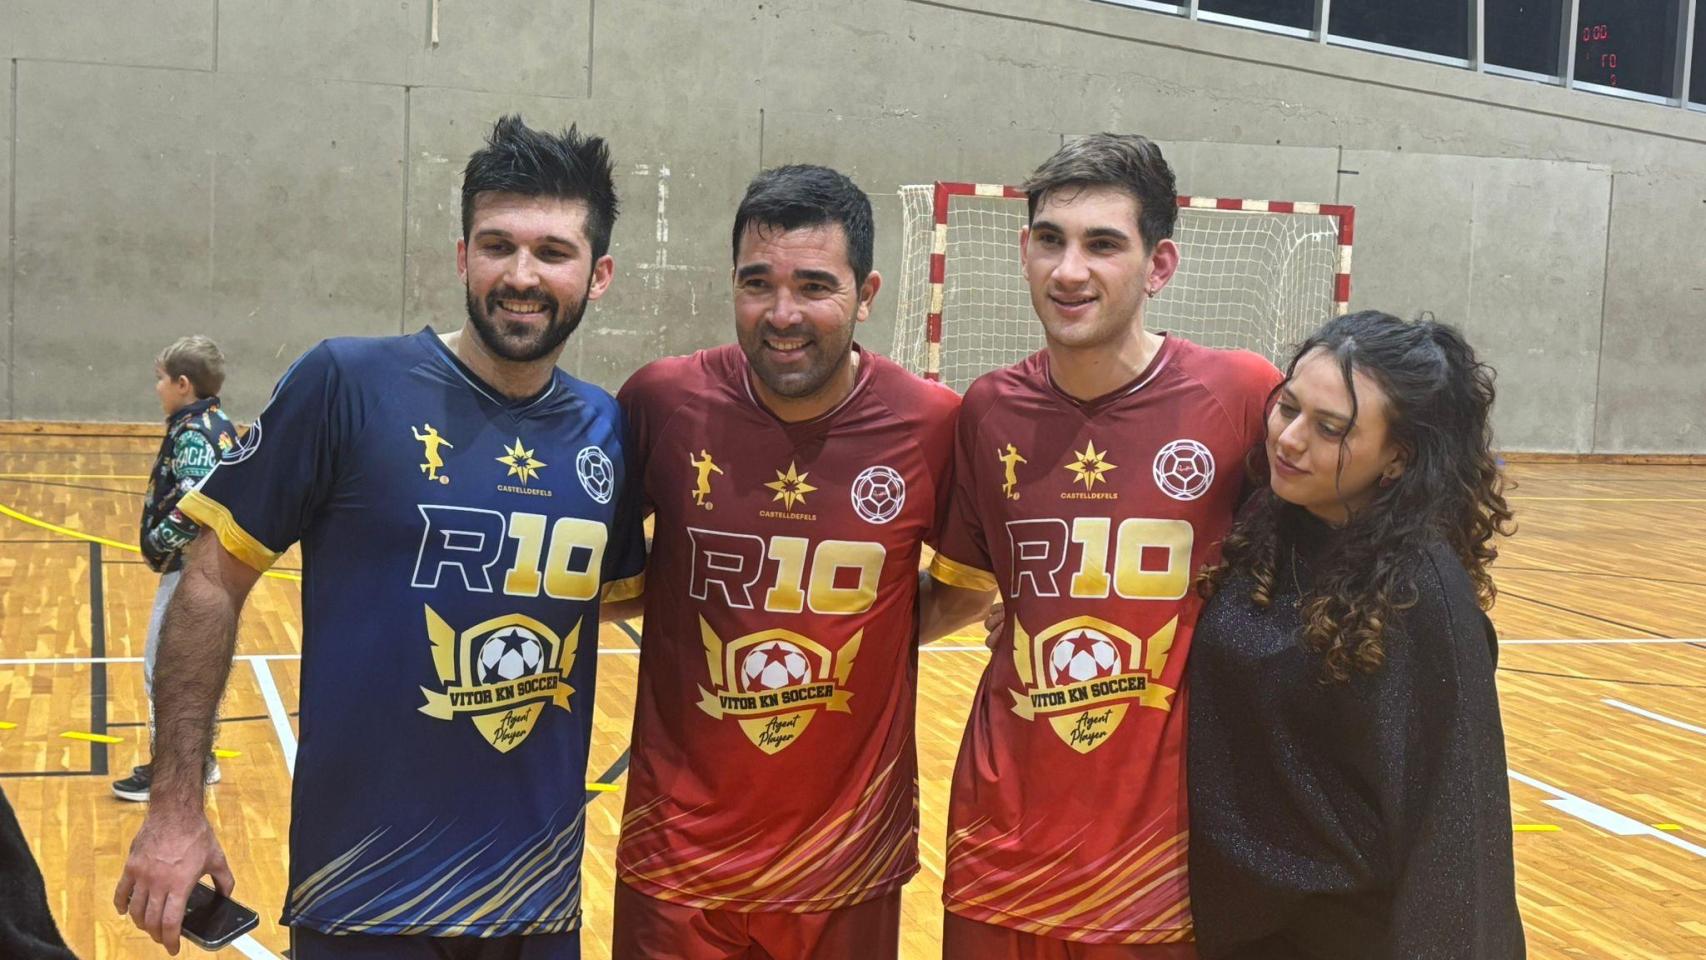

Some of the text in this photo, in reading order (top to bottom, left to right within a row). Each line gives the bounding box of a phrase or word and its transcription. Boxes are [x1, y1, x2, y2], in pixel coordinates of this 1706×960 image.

[497, 484, 552, 497] CASTELLDEFELS
[1061, 492, 1118, 500] CASTELLDEFELS
[759, 510, 817, 521] CASTELLDEFELS
[411, 504, 608, 601] R10
[1005, 517, 1194, 600] R10
[686, 527, 886, 615] R10
[450, 675, 558, 707] VITOR KN SOCCER
[719, 684, 833, 710] VITOR KN SOCCER
[1030, 676, 1147, 708] VITOR KN SOCCER
[500, 708, 531, 729] Agent
[766, 714, 800, 733] Agent
[1076, 709, 1113, 730] Agent
[493, 727, 527, 745] Player
[758, 731, 793, 748] Player
[1070, 730, 1107, 746] Player
